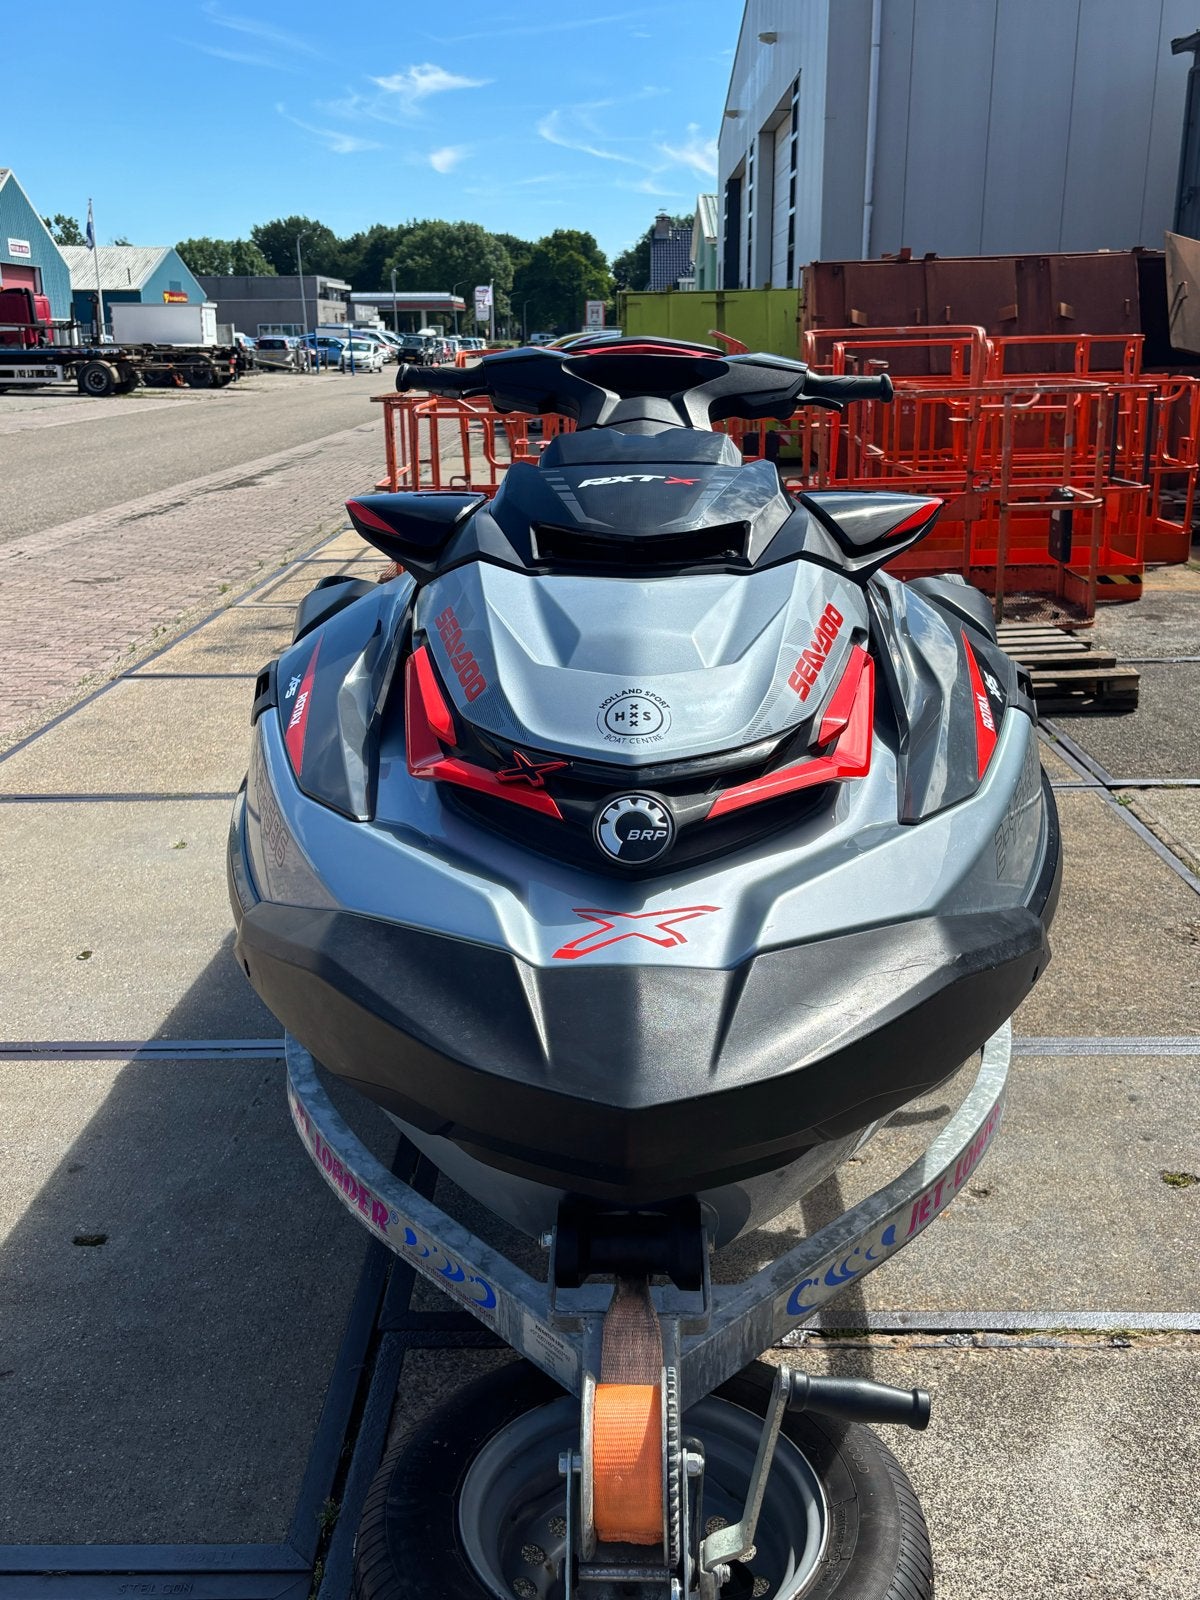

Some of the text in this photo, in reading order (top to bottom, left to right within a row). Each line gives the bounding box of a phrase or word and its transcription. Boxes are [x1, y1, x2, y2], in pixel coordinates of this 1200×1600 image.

[598, 688, 671, 710] HOLLAND SPORT
[975, 691, 996, 732] ROTAX
[603, 733, 664, 745] BOAT CENTRE
[627, 829, 667, 841] BRP
